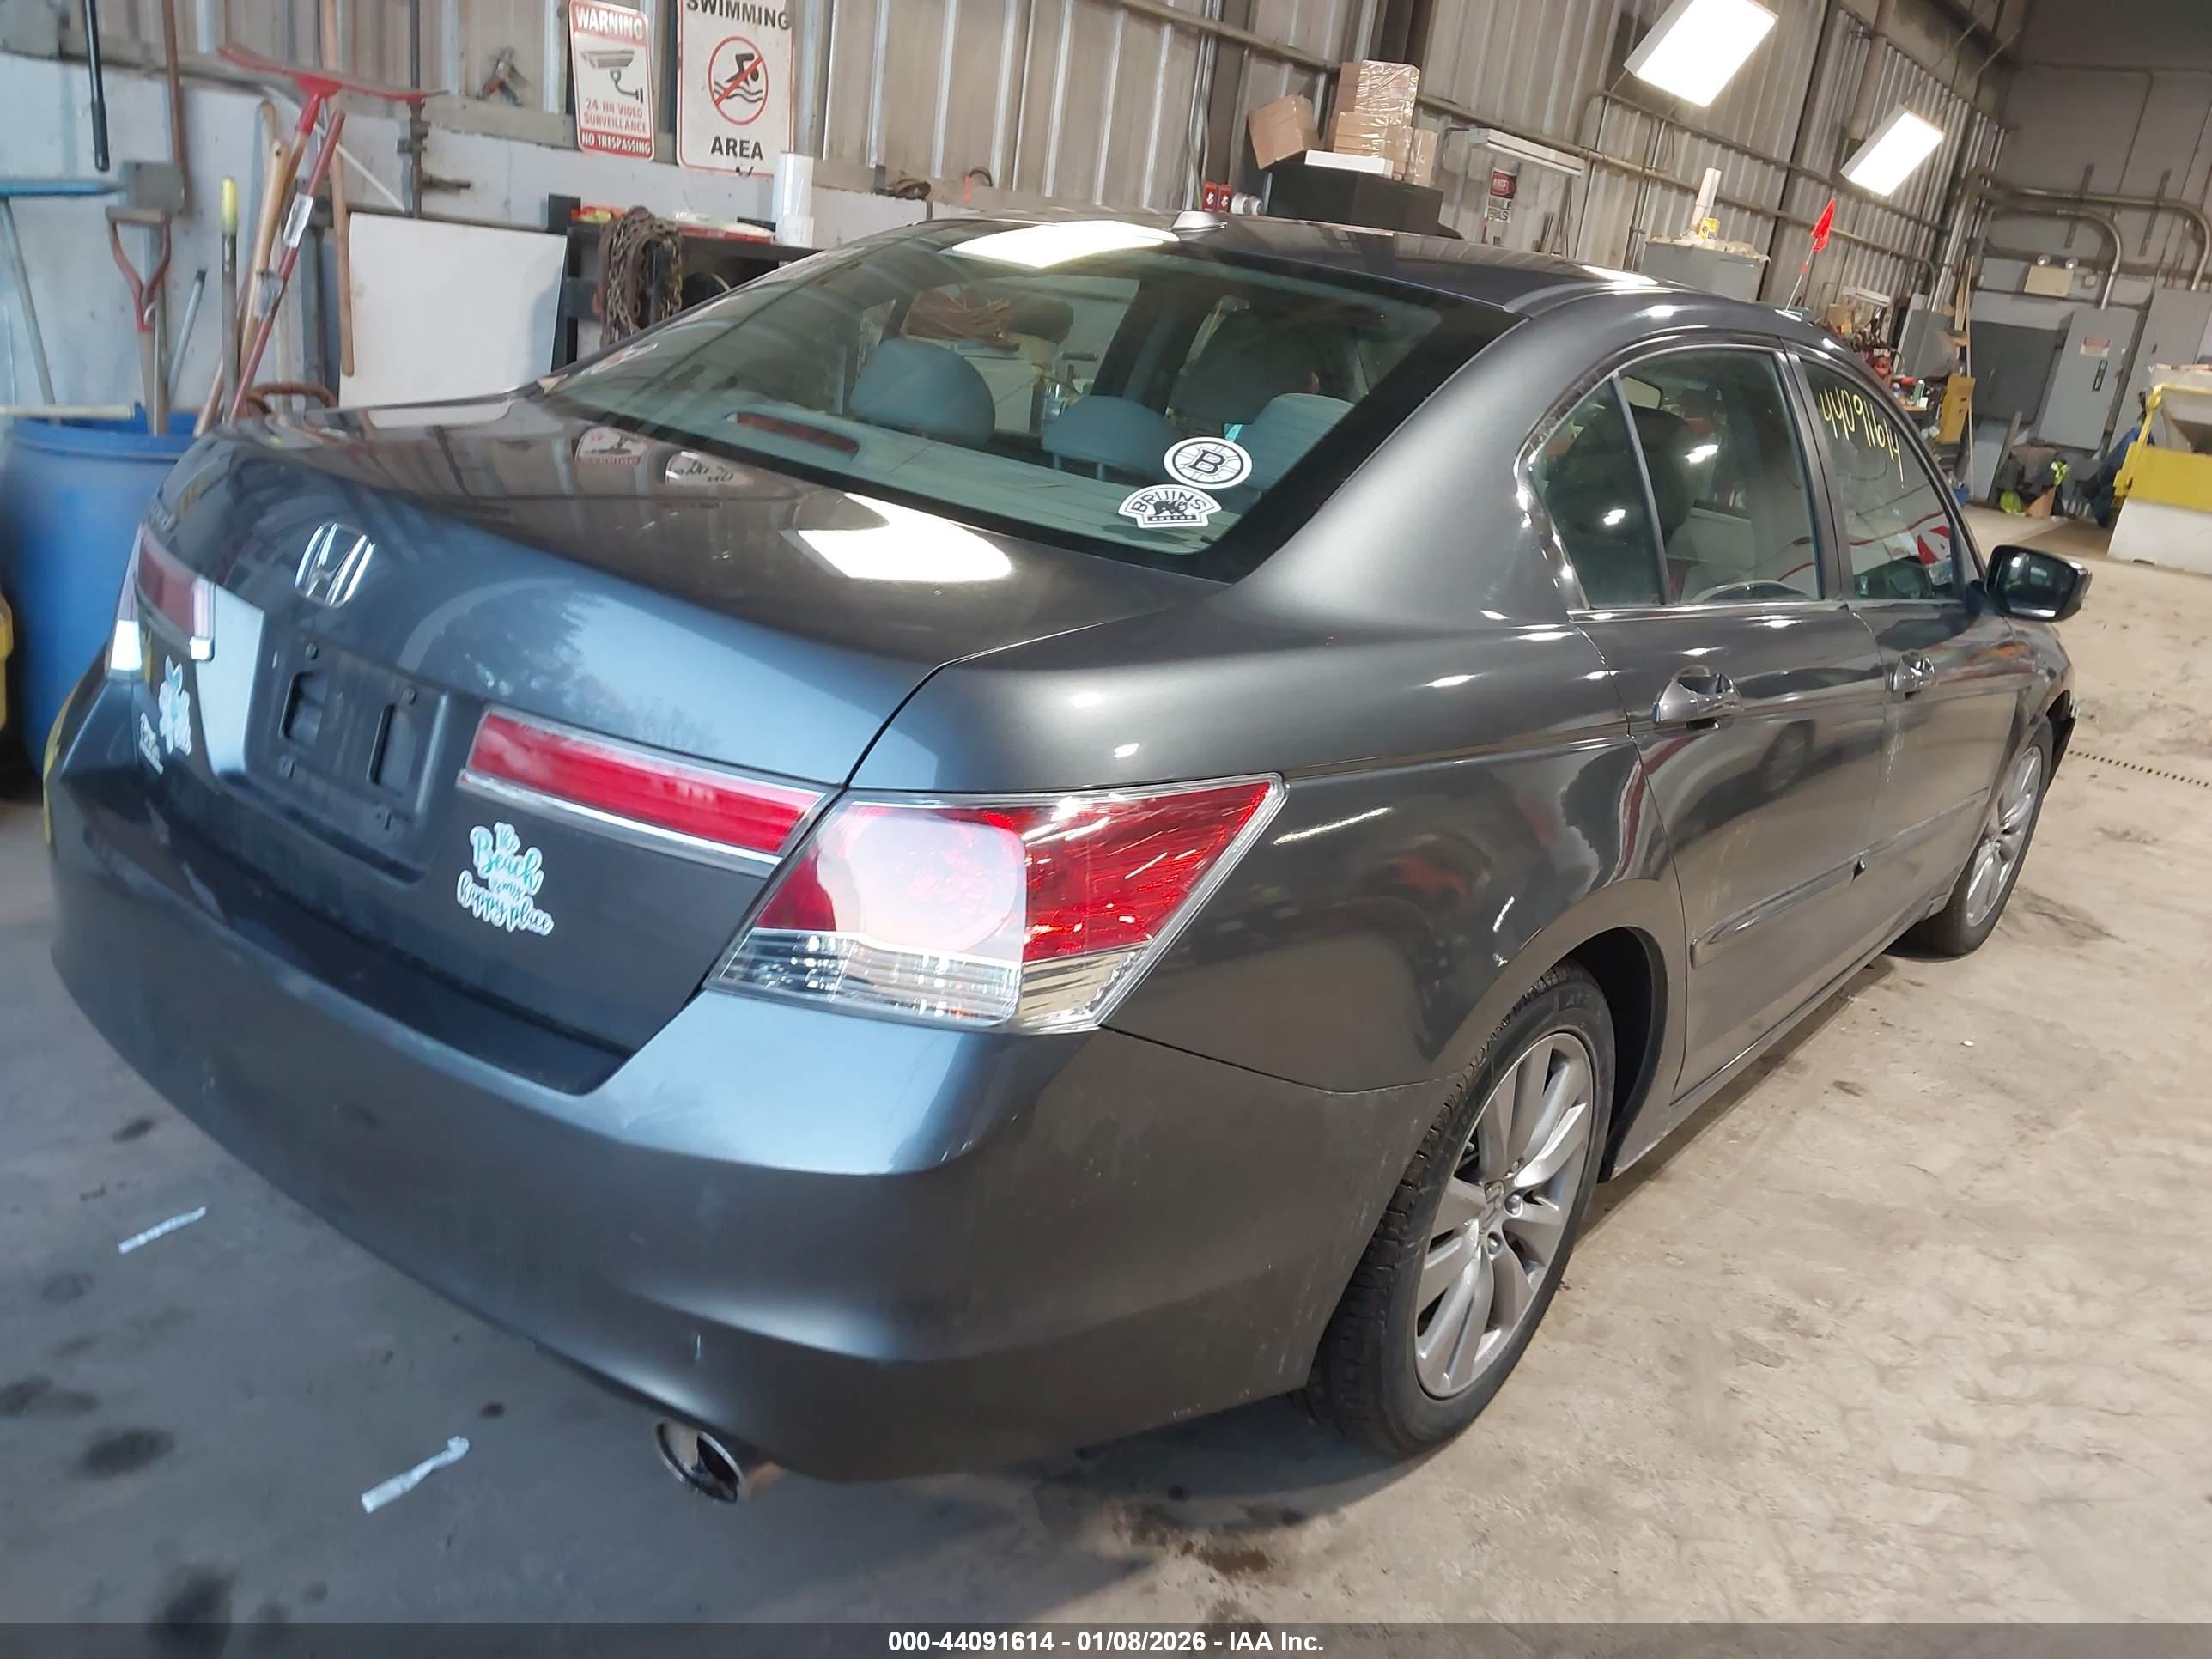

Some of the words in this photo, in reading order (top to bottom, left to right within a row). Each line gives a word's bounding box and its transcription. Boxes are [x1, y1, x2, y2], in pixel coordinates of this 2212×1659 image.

[575, 6, 644, 40] WARNING
[687, 0, 791, 30] SWIMMING
[586, 98, 599, 111] 24
[602, 102, 615, 113] HR
[617, 105, 643, 118] VIDEO
[583, 112, 647, 133] SURVEILLANCE
[581, 131, 595, 147] NO
[596, 135, 651, 155] TRESPASSING
[710, 136, 763, 160] AREA
[1819, 386, 1904, 483] 44091614
[1188, 449, 1226, 474] B
[1131, 489, 1207, 513] BRUINS
